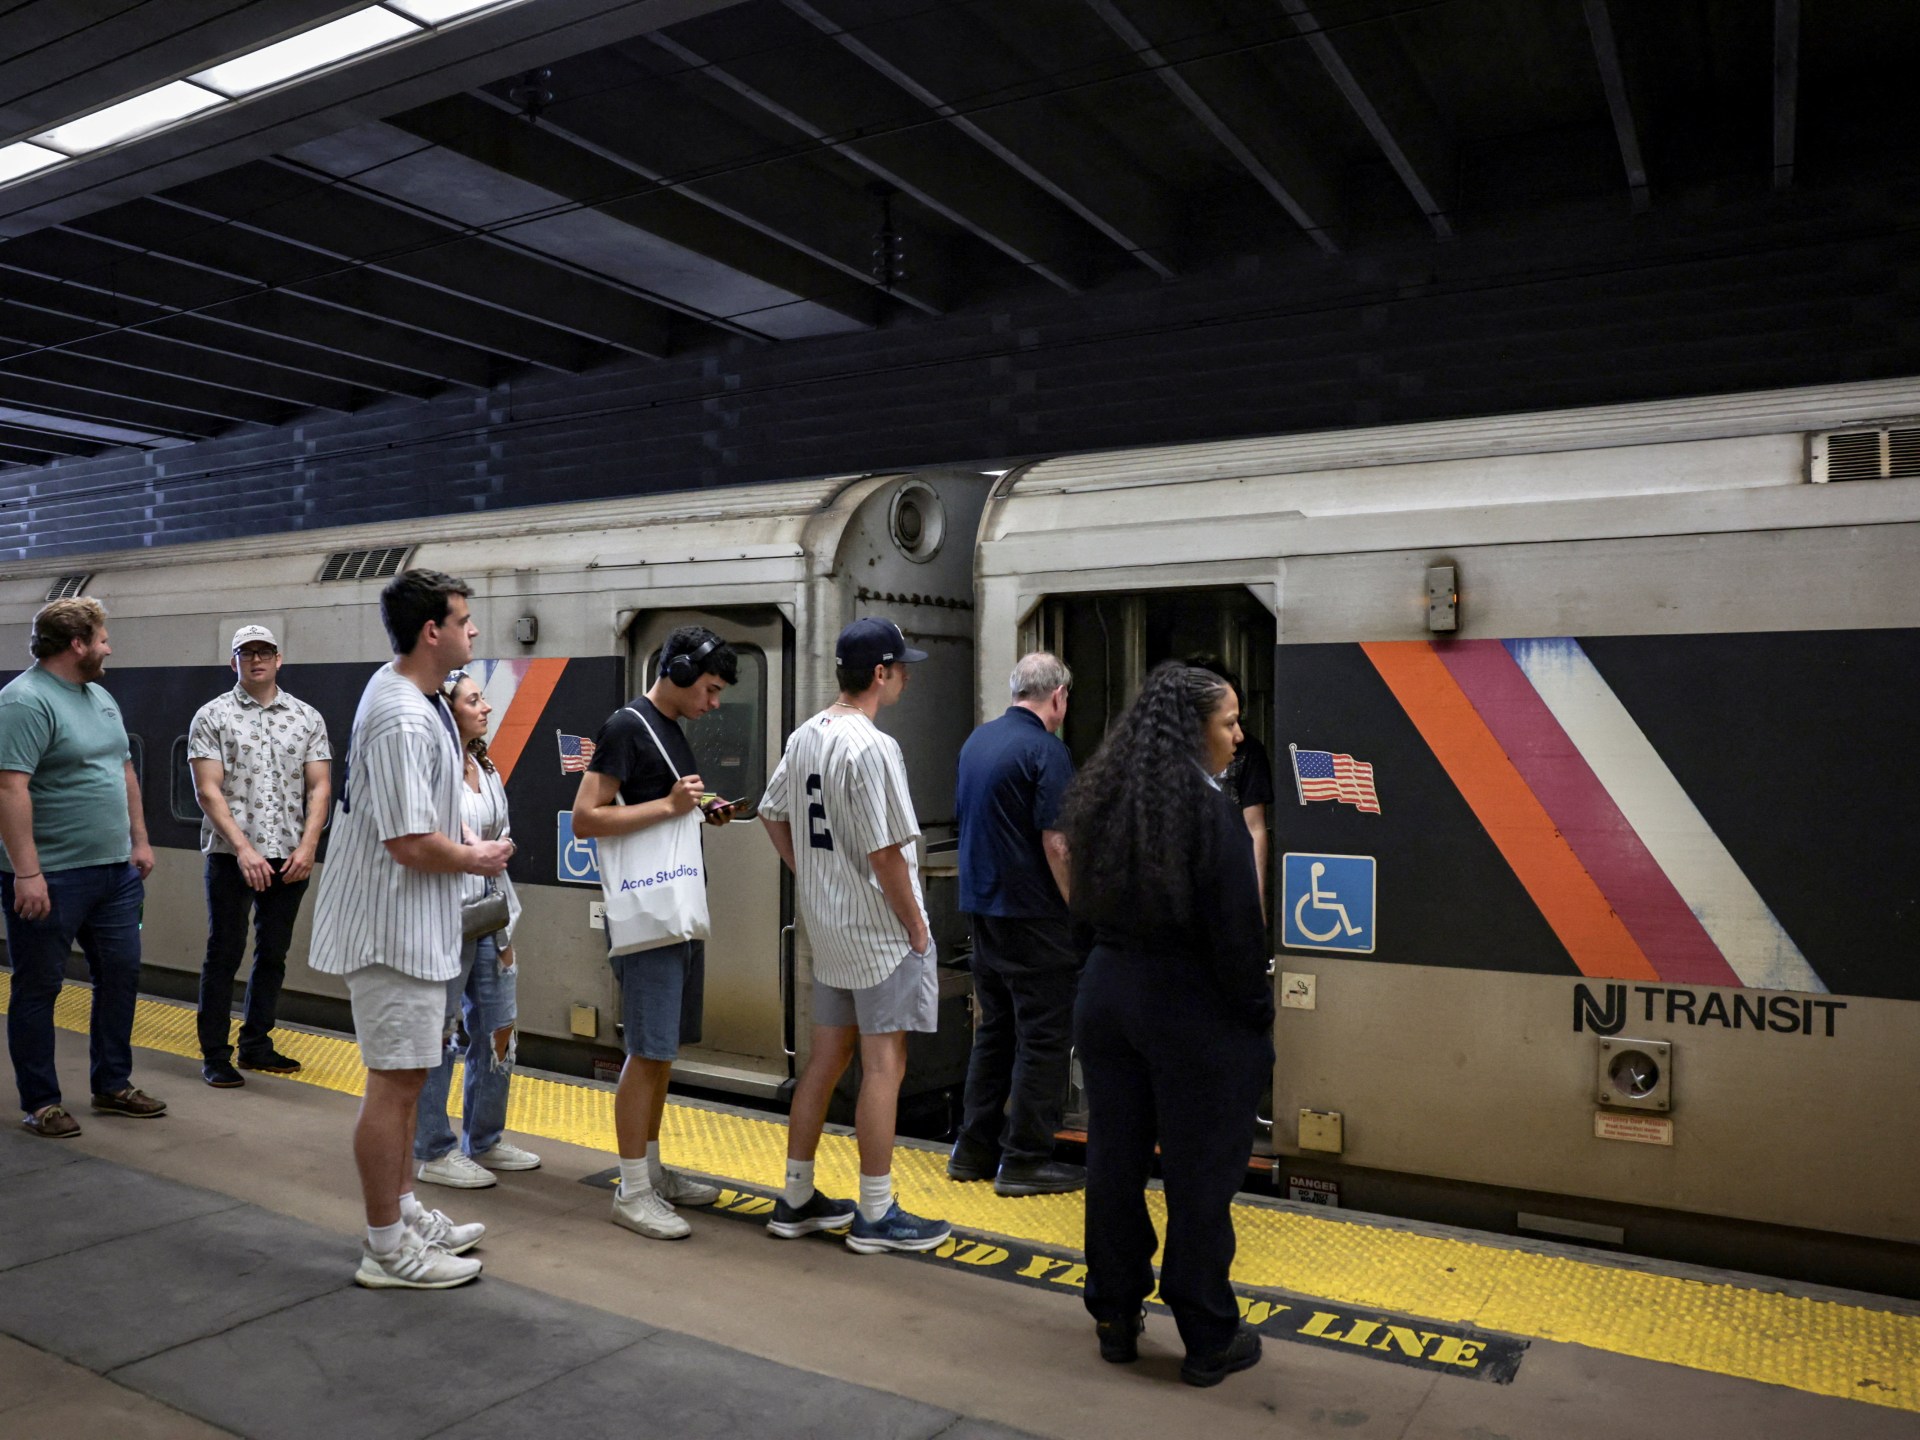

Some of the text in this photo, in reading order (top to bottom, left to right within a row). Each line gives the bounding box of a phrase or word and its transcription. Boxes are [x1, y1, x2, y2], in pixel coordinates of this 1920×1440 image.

[806, 773, 833, 851] 2
[620, 864, 698, 892] Acne Studios
[1573, 983, 1847, 1037] NJ TRANSIT
[1290, 1177, 1337, 1192] DANGER
[1296, 1311, 1487, 1368] LINE
